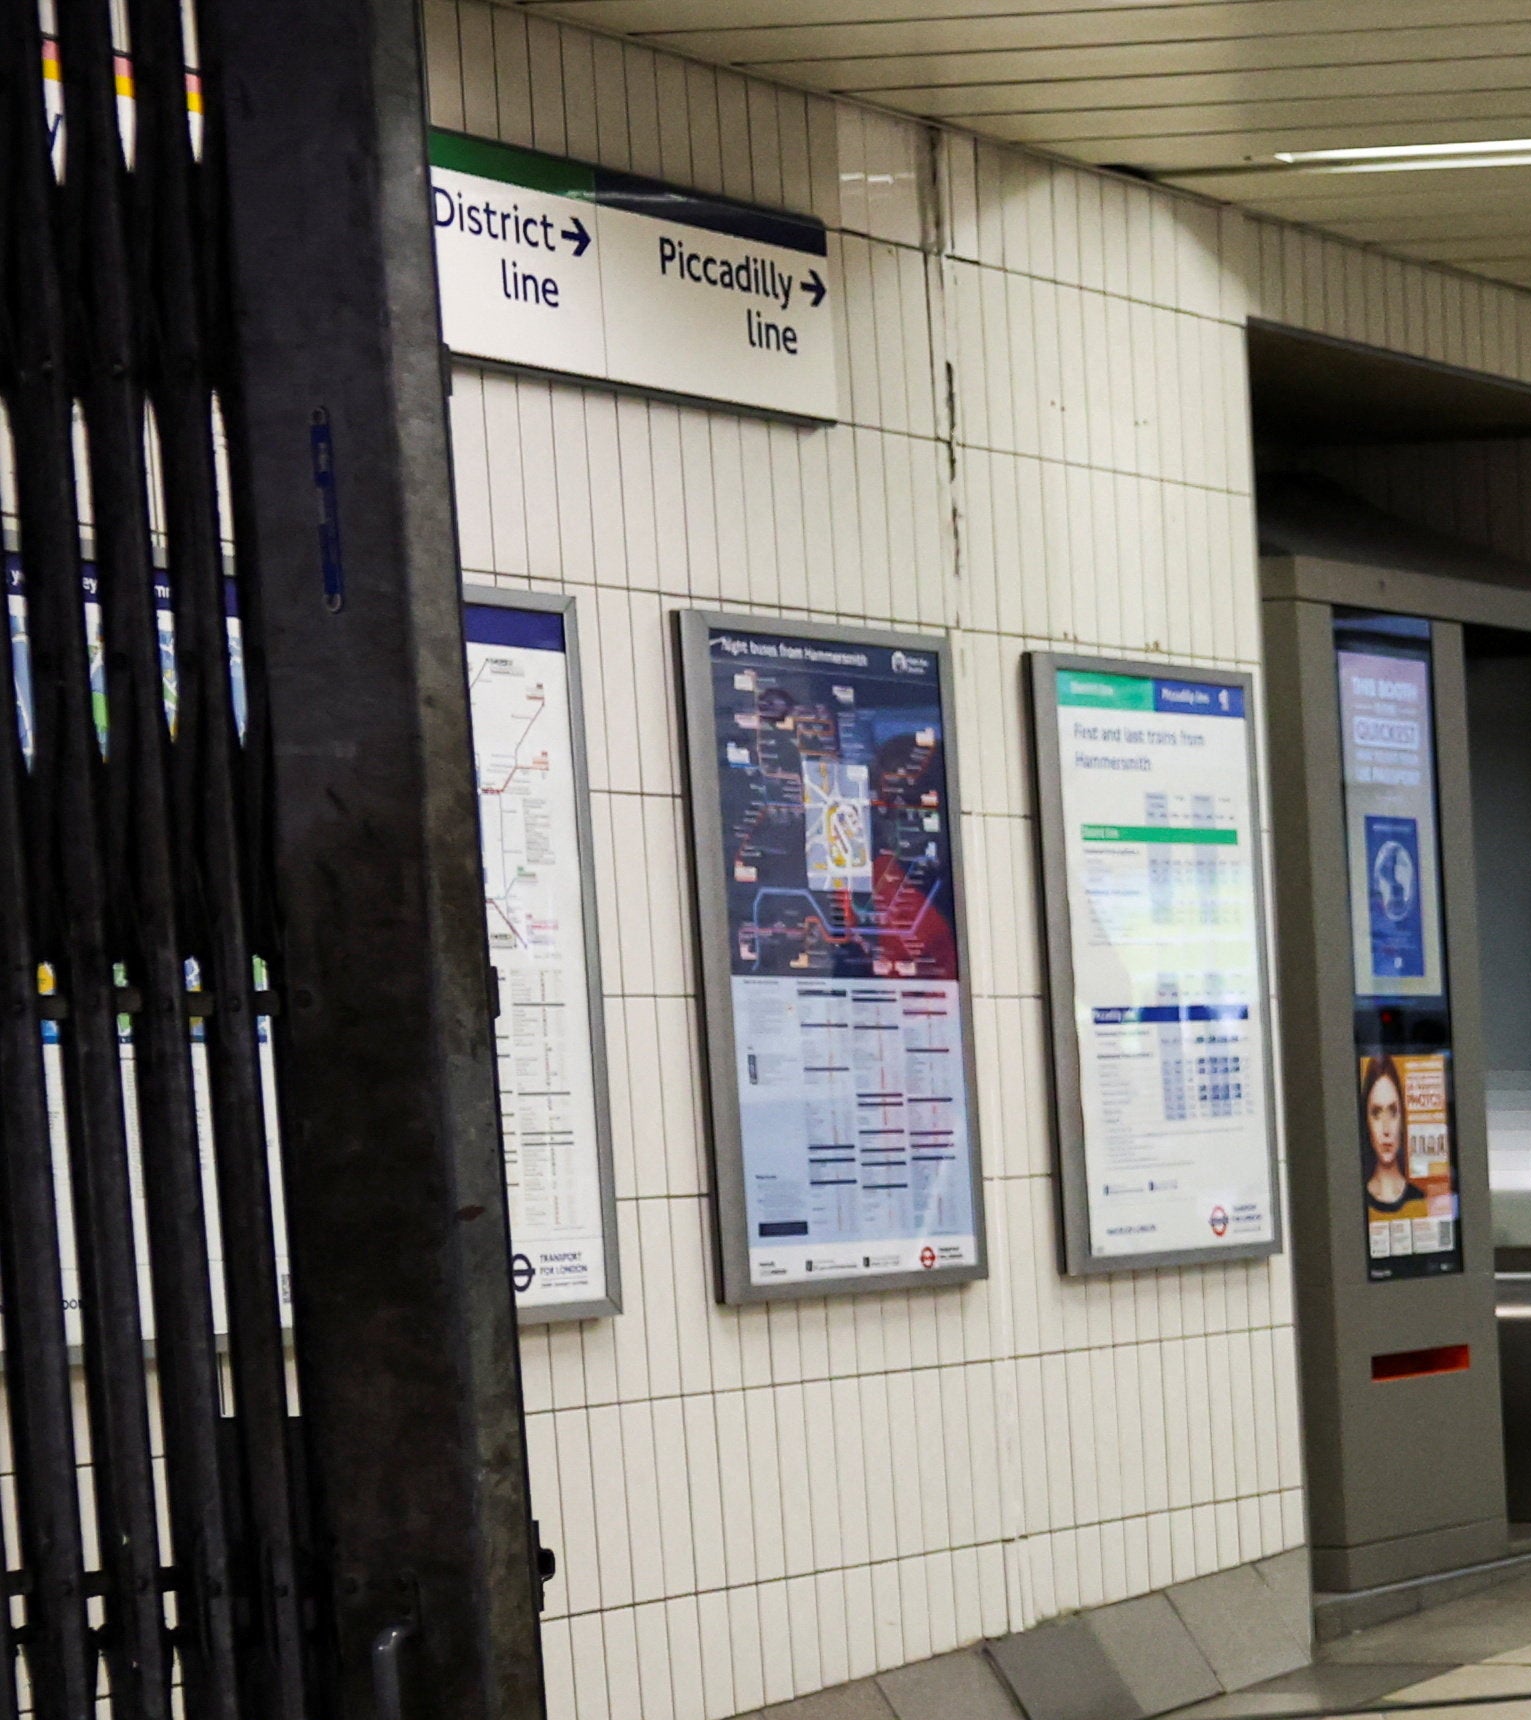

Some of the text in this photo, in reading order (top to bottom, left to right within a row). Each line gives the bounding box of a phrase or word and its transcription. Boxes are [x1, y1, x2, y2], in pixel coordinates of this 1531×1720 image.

[434, 187, 557, 252] District
[500, 258, 561, 308] line
[659, 236, 793, 309] Piccadilly
[747, 309, 798, 355] line
[1074, 722, 1205, 746] First and last trains from
[1075, 752, 1151, 771] Hammersmith
[540, 1252, 582, 1262] TRANSPORT
[541, 1264, 588, 1275] FOR LONDON
